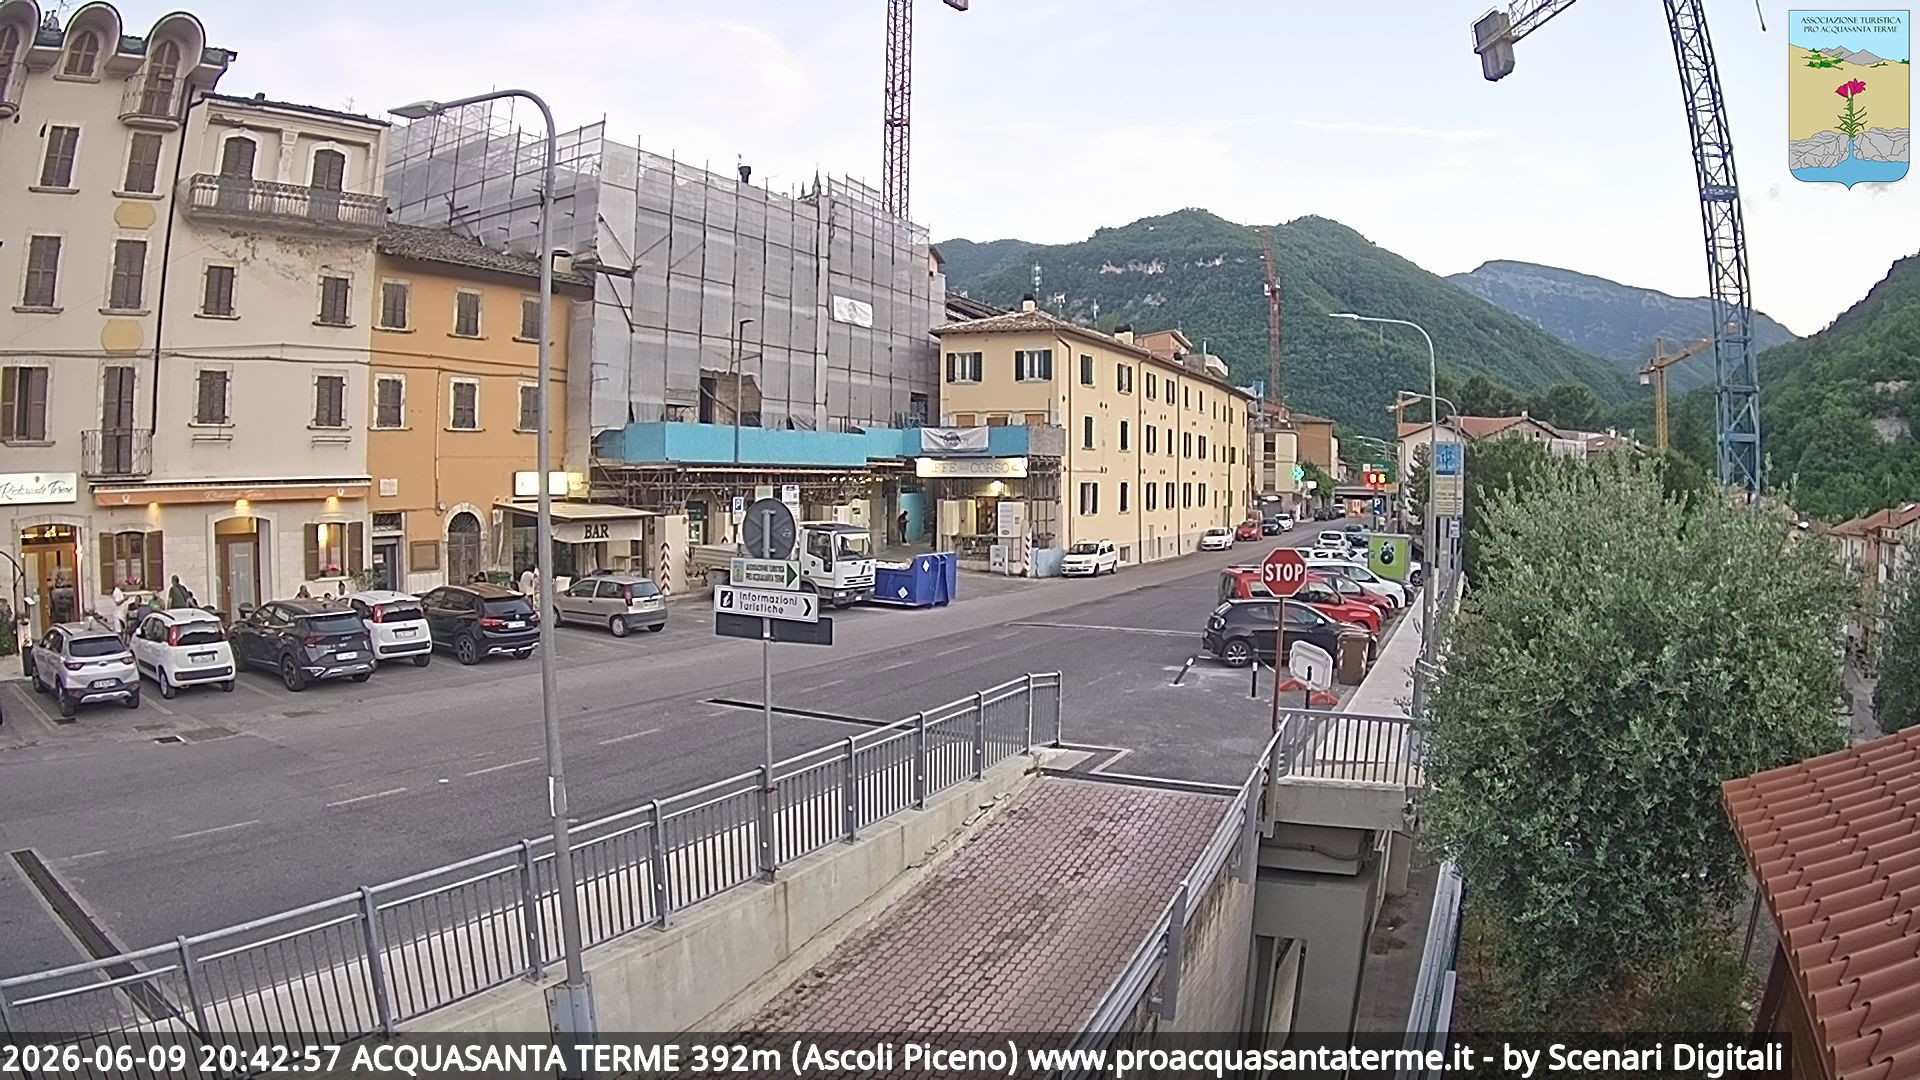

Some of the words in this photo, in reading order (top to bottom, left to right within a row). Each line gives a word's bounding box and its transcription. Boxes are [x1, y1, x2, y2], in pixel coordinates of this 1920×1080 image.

[970, 461, 1010, 474] CORSO
[584, 523, 609, 539] BAR
[1265, 563, 1304, 582] STOP
[739, 592, 797, 606] Informazioni
[740, 601, 784, 614] Turistiche
